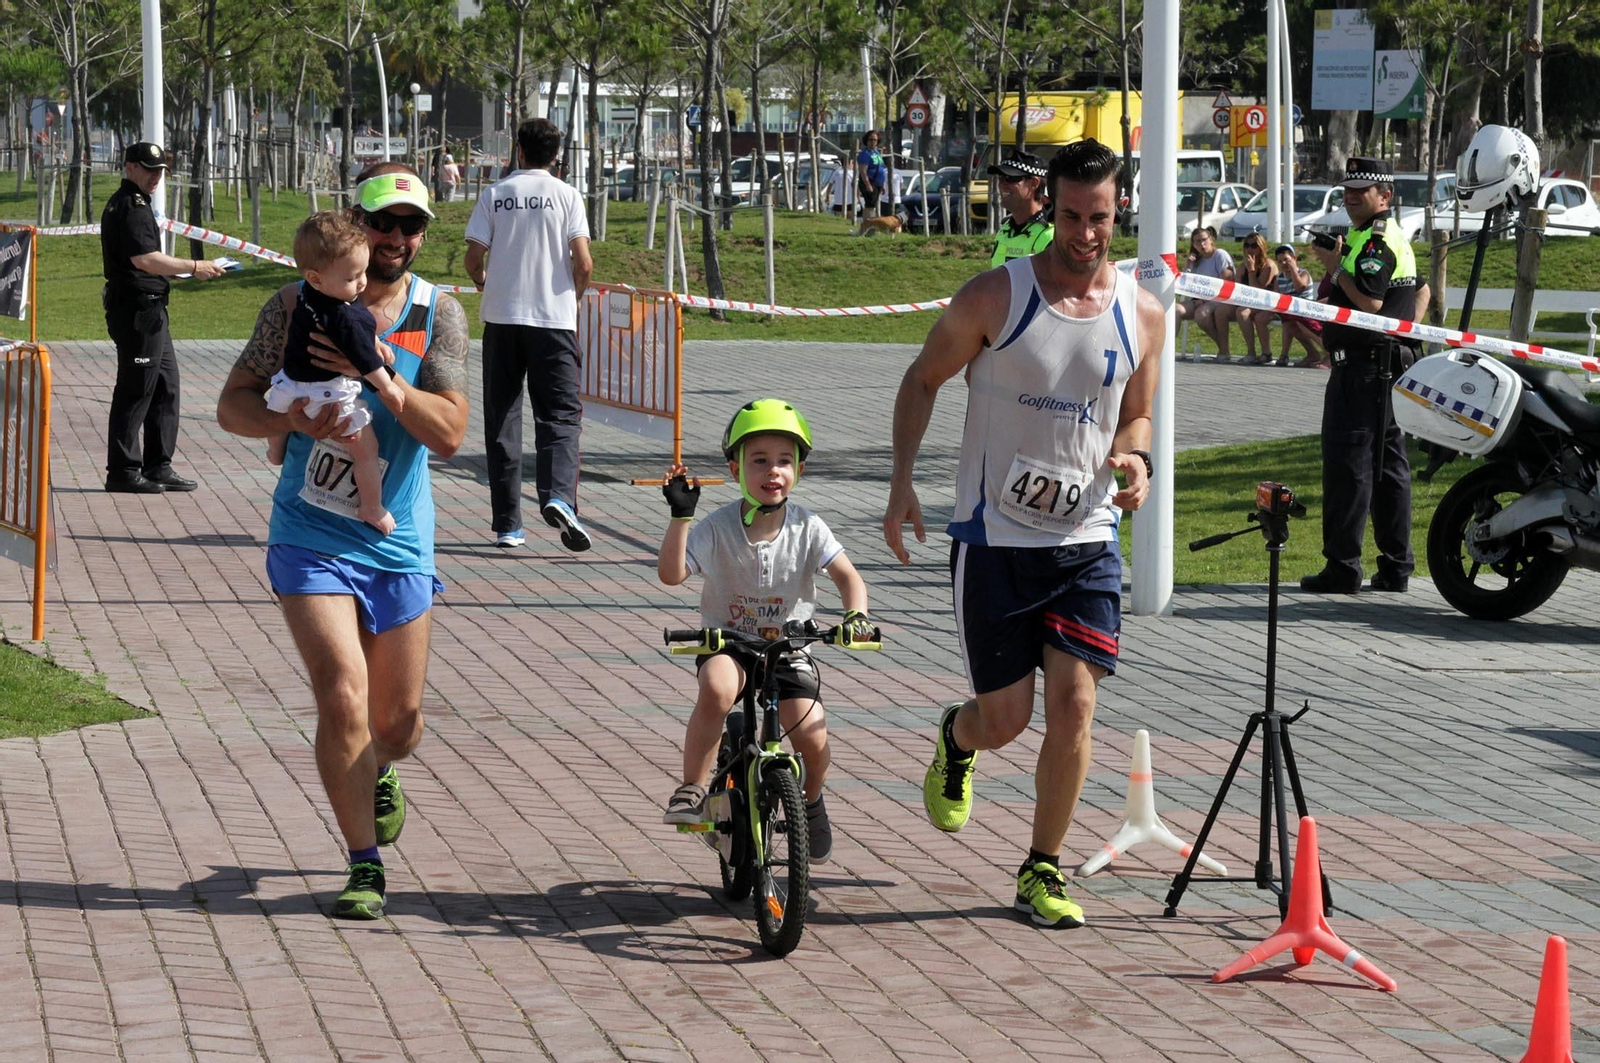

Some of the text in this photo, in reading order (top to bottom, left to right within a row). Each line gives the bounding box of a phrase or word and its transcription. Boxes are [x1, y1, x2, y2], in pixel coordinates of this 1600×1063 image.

[1389, 70, 1410, 79] INSERSA
[911, 112, 924, 120] 30
[1217, 114, 1229, 122] 30
[494, 196, 555, 213] POLICIA
[1018, 393, 1084, 413] Golfitness
[1010, 471, 1081, 517] 4219
